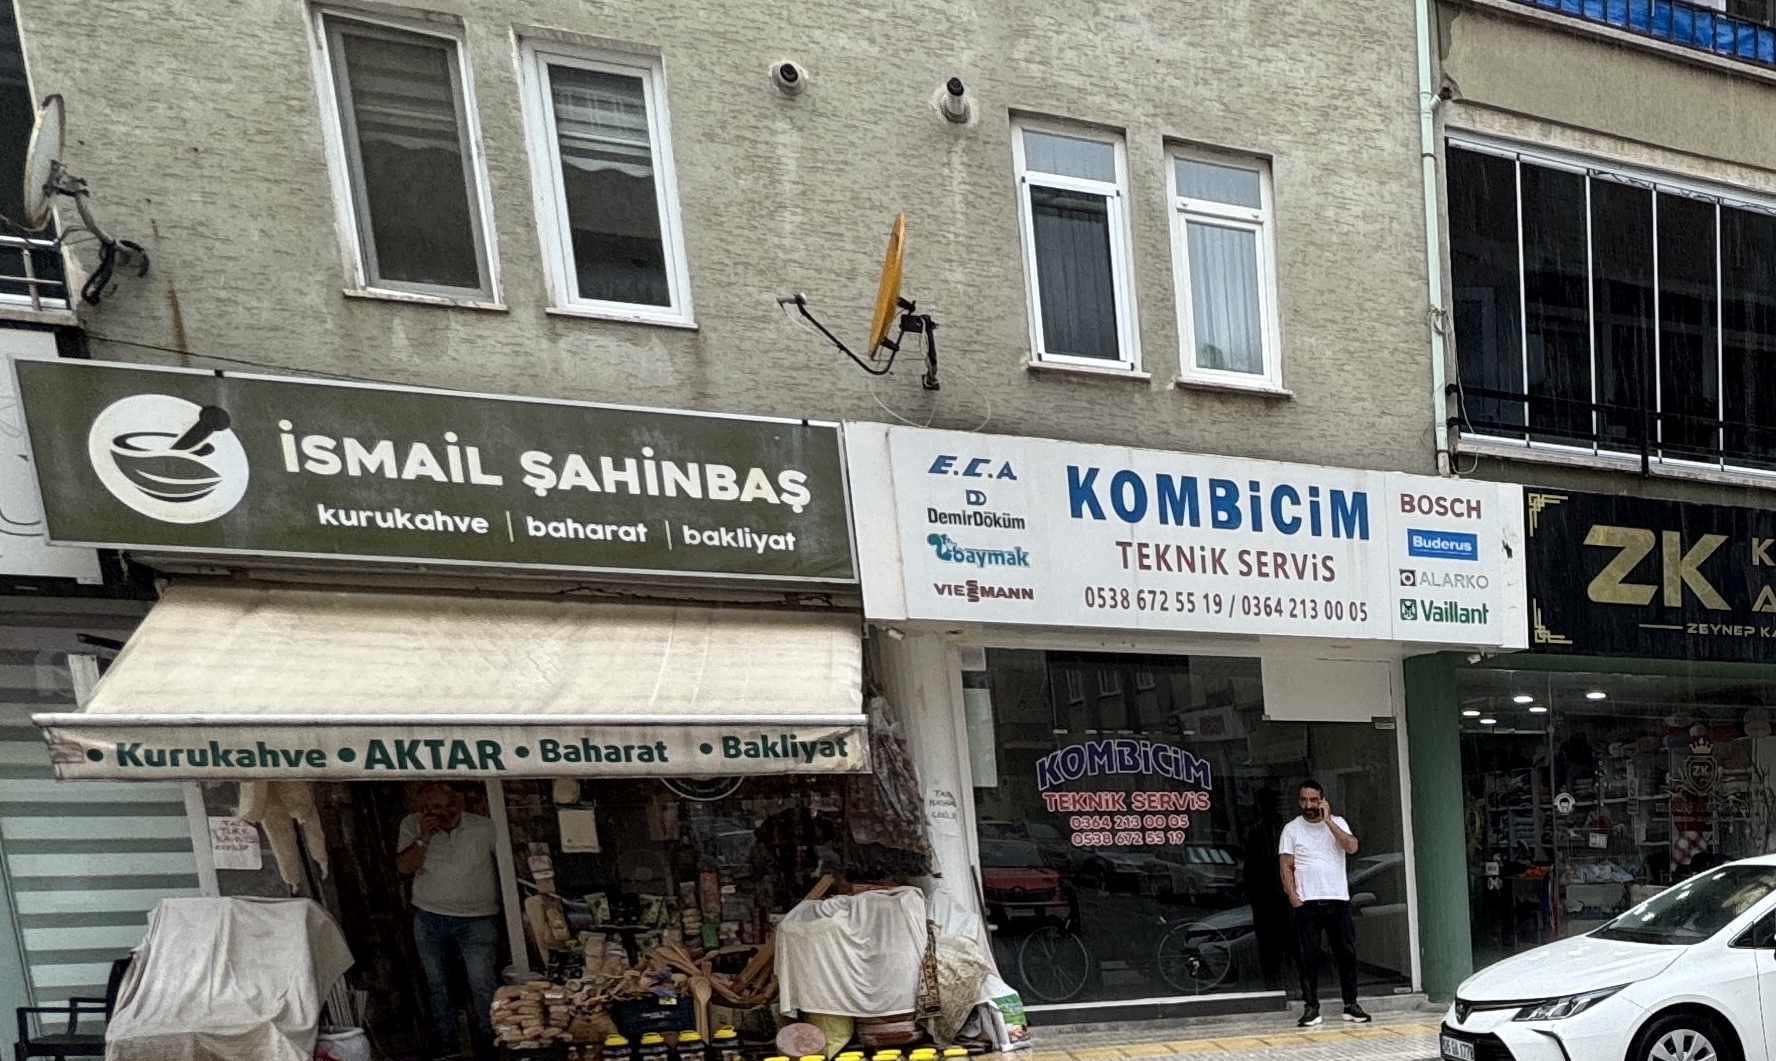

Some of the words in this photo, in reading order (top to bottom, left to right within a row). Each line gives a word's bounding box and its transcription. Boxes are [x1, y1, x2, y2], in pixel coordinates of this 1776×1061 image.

[278, 419, 503, 486] İSMAİL
[520, 447, 811, 513] ŞAHİNBAŞ
[1400, 493, 1482, 519] BOSCH
[317, 504, 489, 534] kurukahve
[526, 516, 648, 542] baharat
[682, 525, 796, 554] bakliyat
[927, 508, 1026, 530] DemirDöküm
[1412, 535, 1472, 552] Buderus
[953, 546, 1030, 568] baymak
[1583, 524, 1732, 611] ZK
[1419, 572, 1489, 589] ALARKO
[1085, 586, 1130, 609] 0538
[1136, 589, 1169, 611] 672
[1175, 591, 1196, 613] 55
[1203, 593, 1223, 614] 19
[1229, 594, 1236, 618] /
[1242, 595, 1283, 617] 0364
[1289, 598, 1318, 619] 213
[1324, 600, 1343, 621] 00
[1350, 602, 1368, 622] 05
[1420, 600, 1489, 625] Vaillant
[1686, 622, 1755, 637] ZEYNEP
[116, 741, 326, 769] Kurukahve
[364, 739, 505, 770] AKTAR
[540, 738, 669, 763] Baharat
[722, 734, 848, 764] Bakliyat
[1070, 815, 1112, 830] 0364
[1114, 815, 1141, 829] 213
[1143, 814, 1166, 829] 00
[1168, 814, 1189, 828] 05
[1071, 831, 1112, 846] 0538
[1115, 831, 1143, 845] 672
[1145, 831, 1165, 845] 55
[1168, 831, 1185, 844] 19
